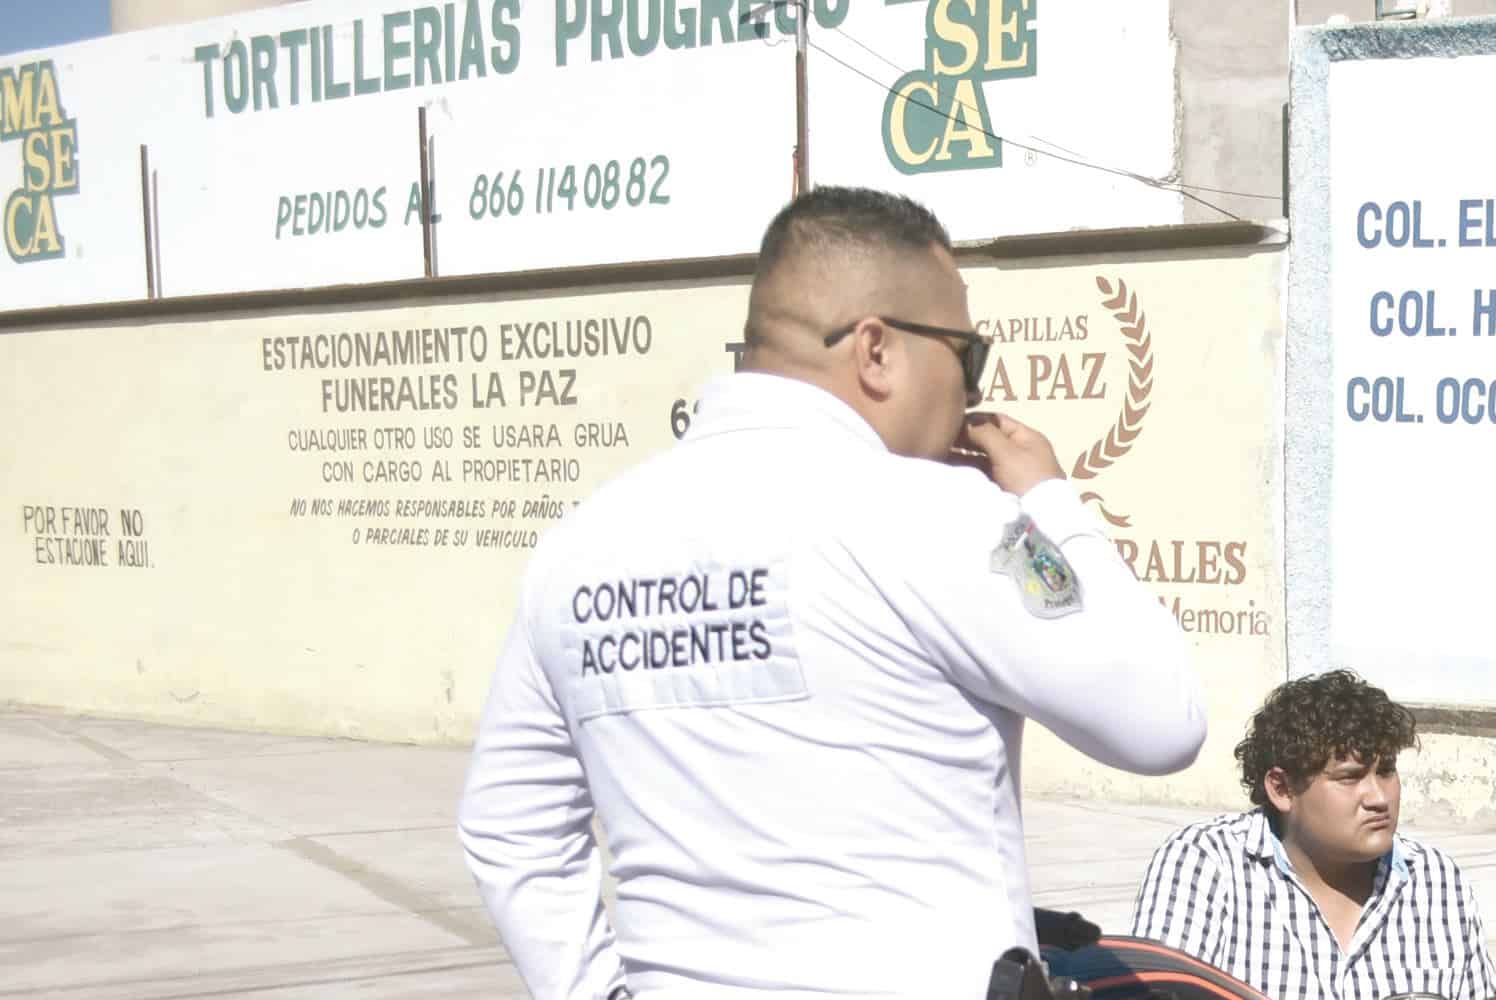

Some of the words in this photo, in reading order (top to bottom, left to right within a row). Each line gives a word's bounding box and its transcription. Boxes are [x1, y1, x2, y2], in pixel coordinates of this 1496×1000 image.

[194, 0, 521, 119] TORTILLERIAS
[889, 78, 996, 165] CA
[24, 128, 77, 194] SE
[6, 193, 62, 257] CA
[275, 186, 388, 239] PEDIDOS
[468, 169, 526, 221] 866
[1357, 200, 1447, 249] COL.
[975, 313, 1089, 344] CAPILLAS
[1369, 289, 1457, 338] COL.
[262, 326, 488, 371] ESTACIONAMIENTO
[500, 314, 652, 360] EXCLUSIVO
[321, 373, 459, 413] FUNERALES
[471, 372, 506, 409] LA
[519, 368, 578, 407] PAZ
[1026, 351, 1108, 401] PAZ
[1346, 375, 1424, 424] COL.
[288, 427, 367, 452] CUALQUIER
[373, 426, 416, 449] OTRO
[423, 425, 454, 449] USO
[462, 424, 482, 449] SE
[492, 424, 562, 449] USARA
[573, 422, 630, 448] GRUA
[322, 460, 354, 483] CON
[362, 459, 423, 483] CARGO
[431, 459, 453, 482] AL
[462, 458, 581, 483] PROPIETARIO
[23, 505, 57, 535] POR
[61, 506, 111, 537] FAVOR
[120, 508, 144, 537] NO
[289, 498, 307, 517] NO
[310, 499, 334, 517] NOS
[337, 499, 390, 518] HACEMOS
[395, 499, 486, 519] RESPONSABLES
[491, 500, 517, 519] POR
[521, 493, 566, 520] DAÑOS
[35, 536, 109, 567] ESTACIONE
[351, 527, 361, 545] O
[365, 527, 430, 546] PARCIALES
[433, 528, 449, 547] DE
[452, 528, 468, 547] SU
[475, 529, 539, 549] VEHICULO
[572, 573, 718, 624] CONTROL
[728, 568, 769, 610] DE
[581, 620, 772, 678] ACCIDENTES
